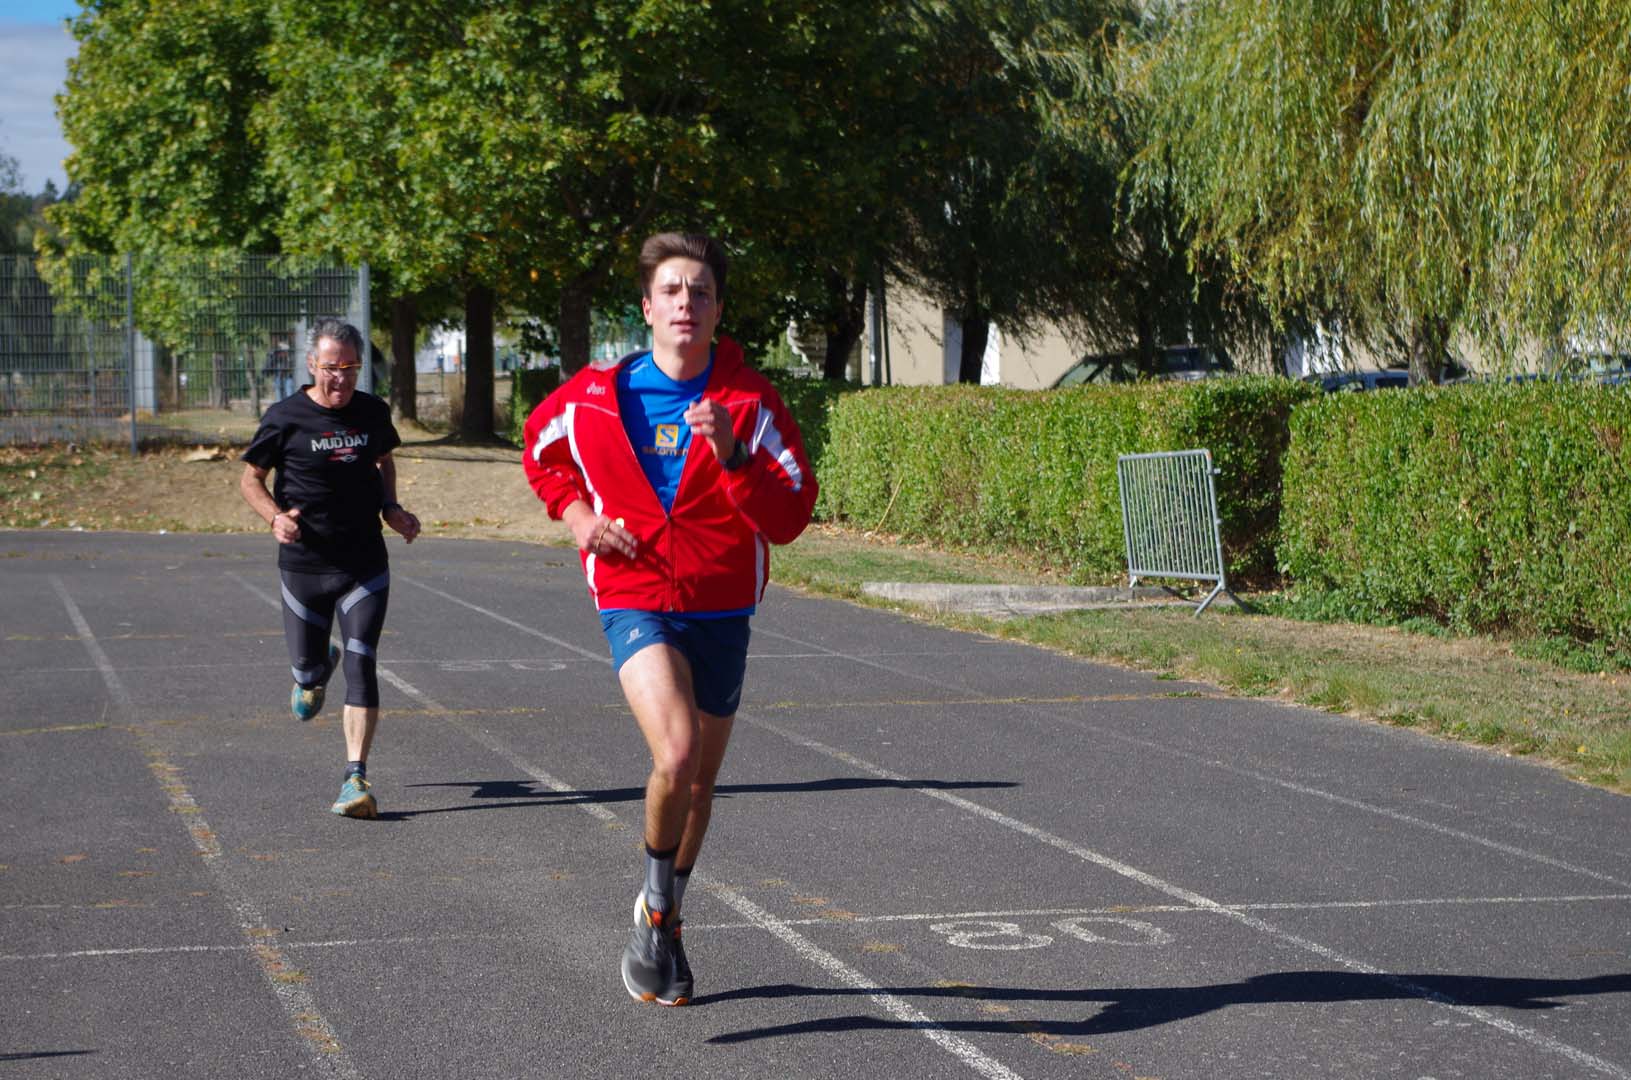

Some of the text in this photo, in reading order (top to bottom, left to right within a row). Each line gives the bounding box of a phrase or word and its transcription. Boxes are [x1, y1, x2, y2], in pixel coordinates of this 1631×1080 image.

[311, 437, 343, 452] MUD
[345, 433, 369, 448] DAY
[930, 917, 1175, 950] 80
